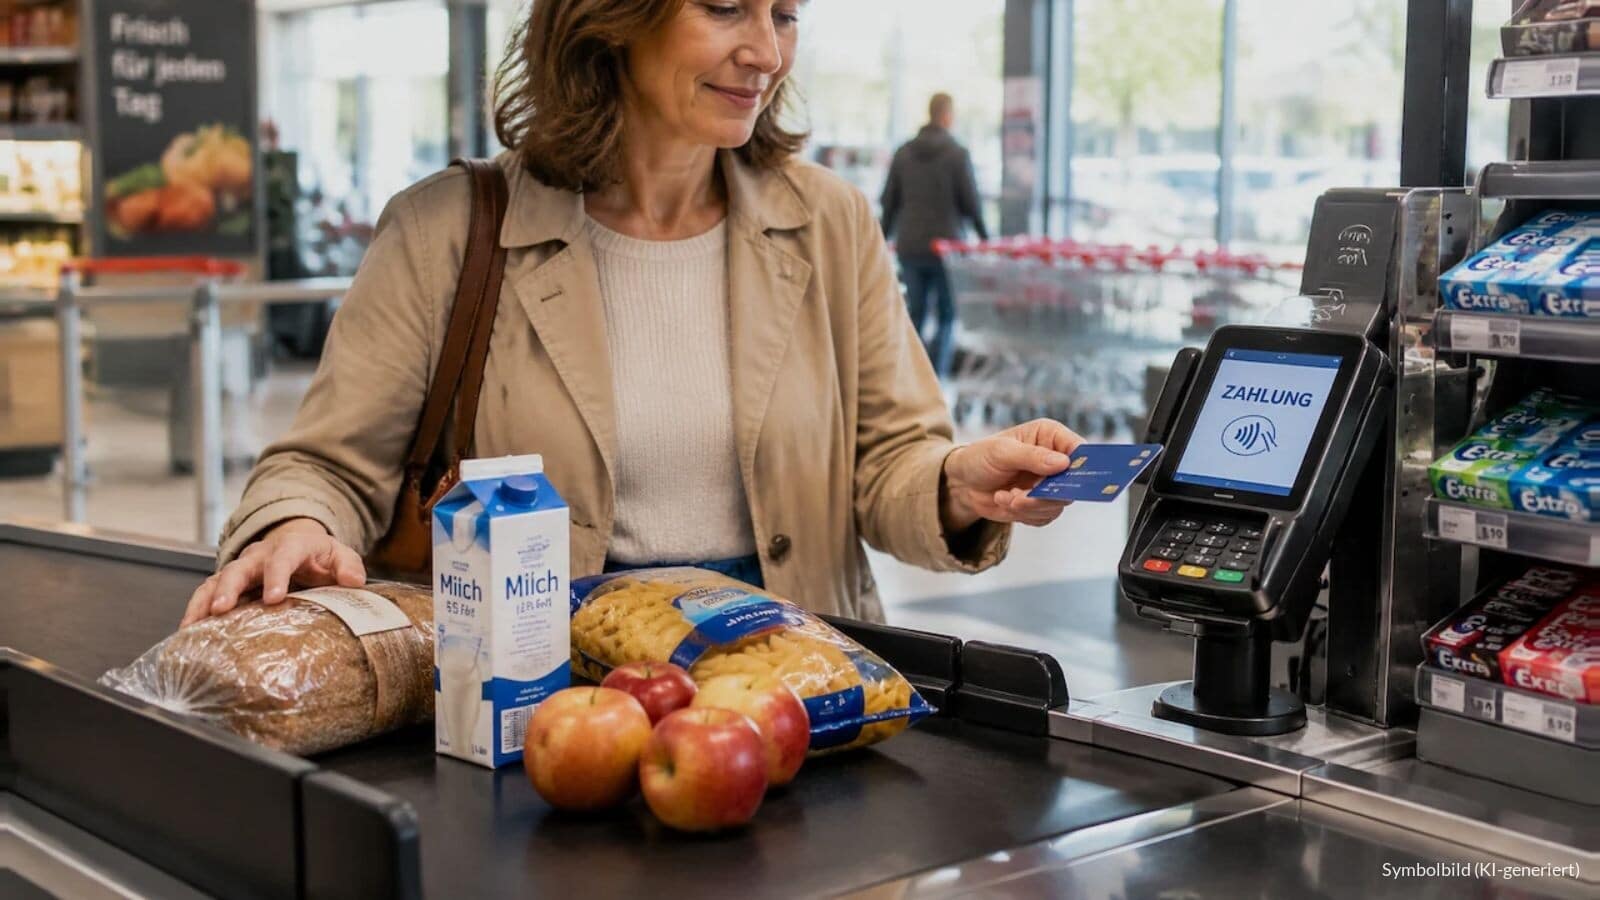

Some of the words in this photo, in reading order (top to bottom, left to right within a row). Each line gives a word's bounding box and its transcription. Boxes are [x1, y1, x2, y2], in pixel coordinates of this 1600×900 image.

[110, 13, 188, 45] Frisch
[112, 50, 150, 80] für
[154, 53, 227, 87] jeden
[111, 85, 163, 123] Tag
[1457, 287, 1510, 310] Extra
[1221, 384, 1313, 408] ZAHLUNG
[505, 568, 559, 601] Milch
